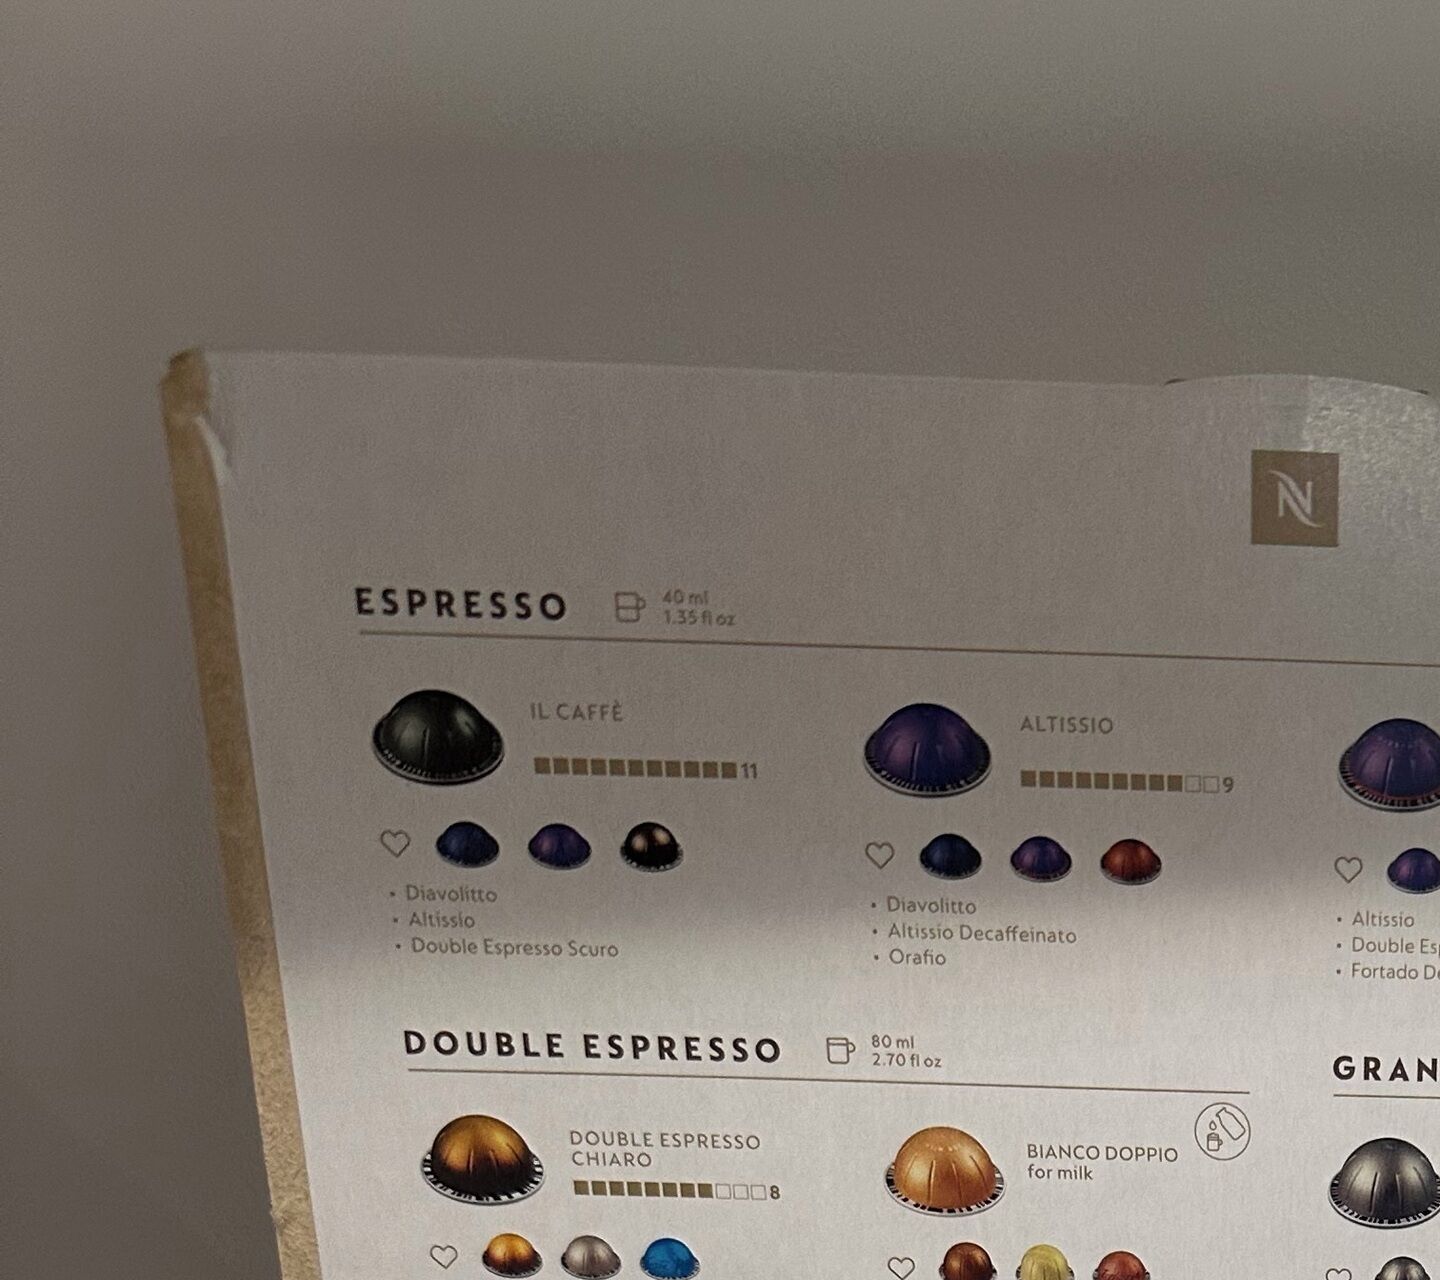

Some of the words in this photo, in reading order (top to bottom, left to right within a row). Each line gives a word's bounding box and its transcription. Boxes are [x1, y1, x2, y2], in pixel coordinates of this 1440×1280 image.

[355, 587, 567, 621] ESPRESSO
[662, 590, 685, 605] 40
[688, 591, 709, 605] ml
[664, 610, 698, 625] 1.35
[702, 610, 715, 625] fl
[716, 614, 737, 626] oz
[530, 703, 550, 720] IL
[556, 700, 623, 722] CAFFÈ
[1020, 716, 1114, 735] ALTISSIO
[741, 763, 758, 779] 11
[1222, 777, 1234, 793] 9
[406, 885, 498, 903] Diavolitto
[887, 896, 977, 915] Diavolitto
[409, 911, 476, 928] Altissio
[1352, 912, 1415, 928] Altissio
[888, 923, 954, 940] Altissio
[959, 924, 1077, 944] Decaffeinato
[412, 937, 478, 955] Double
[484, 939, 563, 959] Espresso
[568, 941, 619, 958] Scuro
[1352, 937, 1415, 955] Double
[889, 948, 947, 966] Orafio
[1352, 963, 1419, 981] Fortado
[404, 1030, 564, 1058] DOUBLE
[584, 1033, 781, 1064] ESPRESSO
[871, 1035, 892, 1049] 80
[896, 1035, 914, 1050] ml
[872, 1053, 906, 1067] 2.70
[910, 1053, 921, 1068] fl
[924, 1056, 942, 1068] oz
[1332, 1055, 1439, 1082] GRAN
[570, 1130, 654, 1148] DOUBLE
[660, 1133, 761, 1150] ESPRESSO
[572, 1151, 653, 1168] CHIARO
[1027, 1144, 1100, 1161] BIANCO
[1105, 1145, 1179, 1163] DOPPIO
[1027, 1164, 1052, 1180] for
[1057, 1165, 1093, 1181] milk
[770, 1185, 781, 1200] 8
